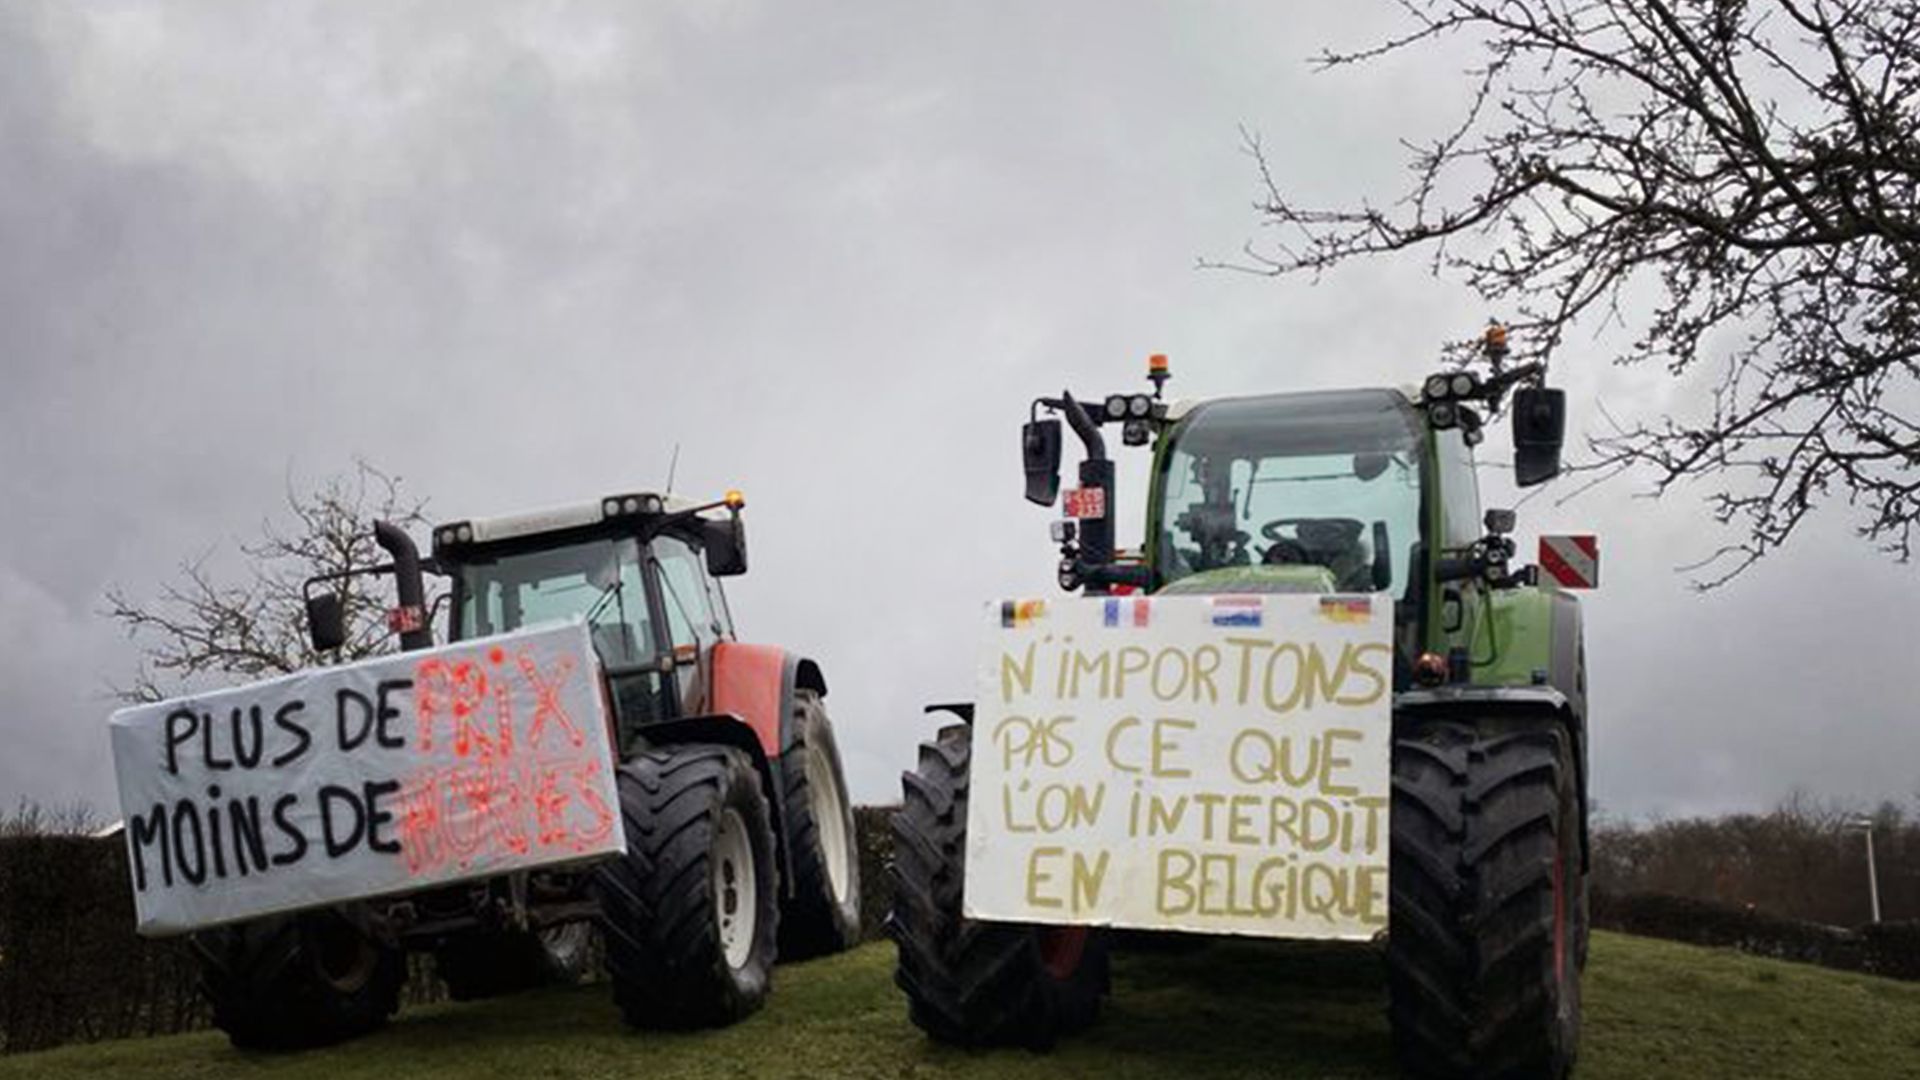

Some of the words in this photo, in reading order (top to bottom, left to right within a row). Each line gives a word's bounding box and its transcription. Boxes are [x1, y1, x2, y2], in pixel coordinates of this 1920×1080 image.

[165, 701, 311, 774] PLUS
[336, 680, 413, 751] DE
[993, 716, 1076, 772] PAS
[1105, 716, 1196, 778] CE
[1229, 728, 1364, 796] QUE
[318, 780, 400, 858] DE
[1003, 779, 1105, 833] L'ON
[1026, 847, 1109, 914] EN
